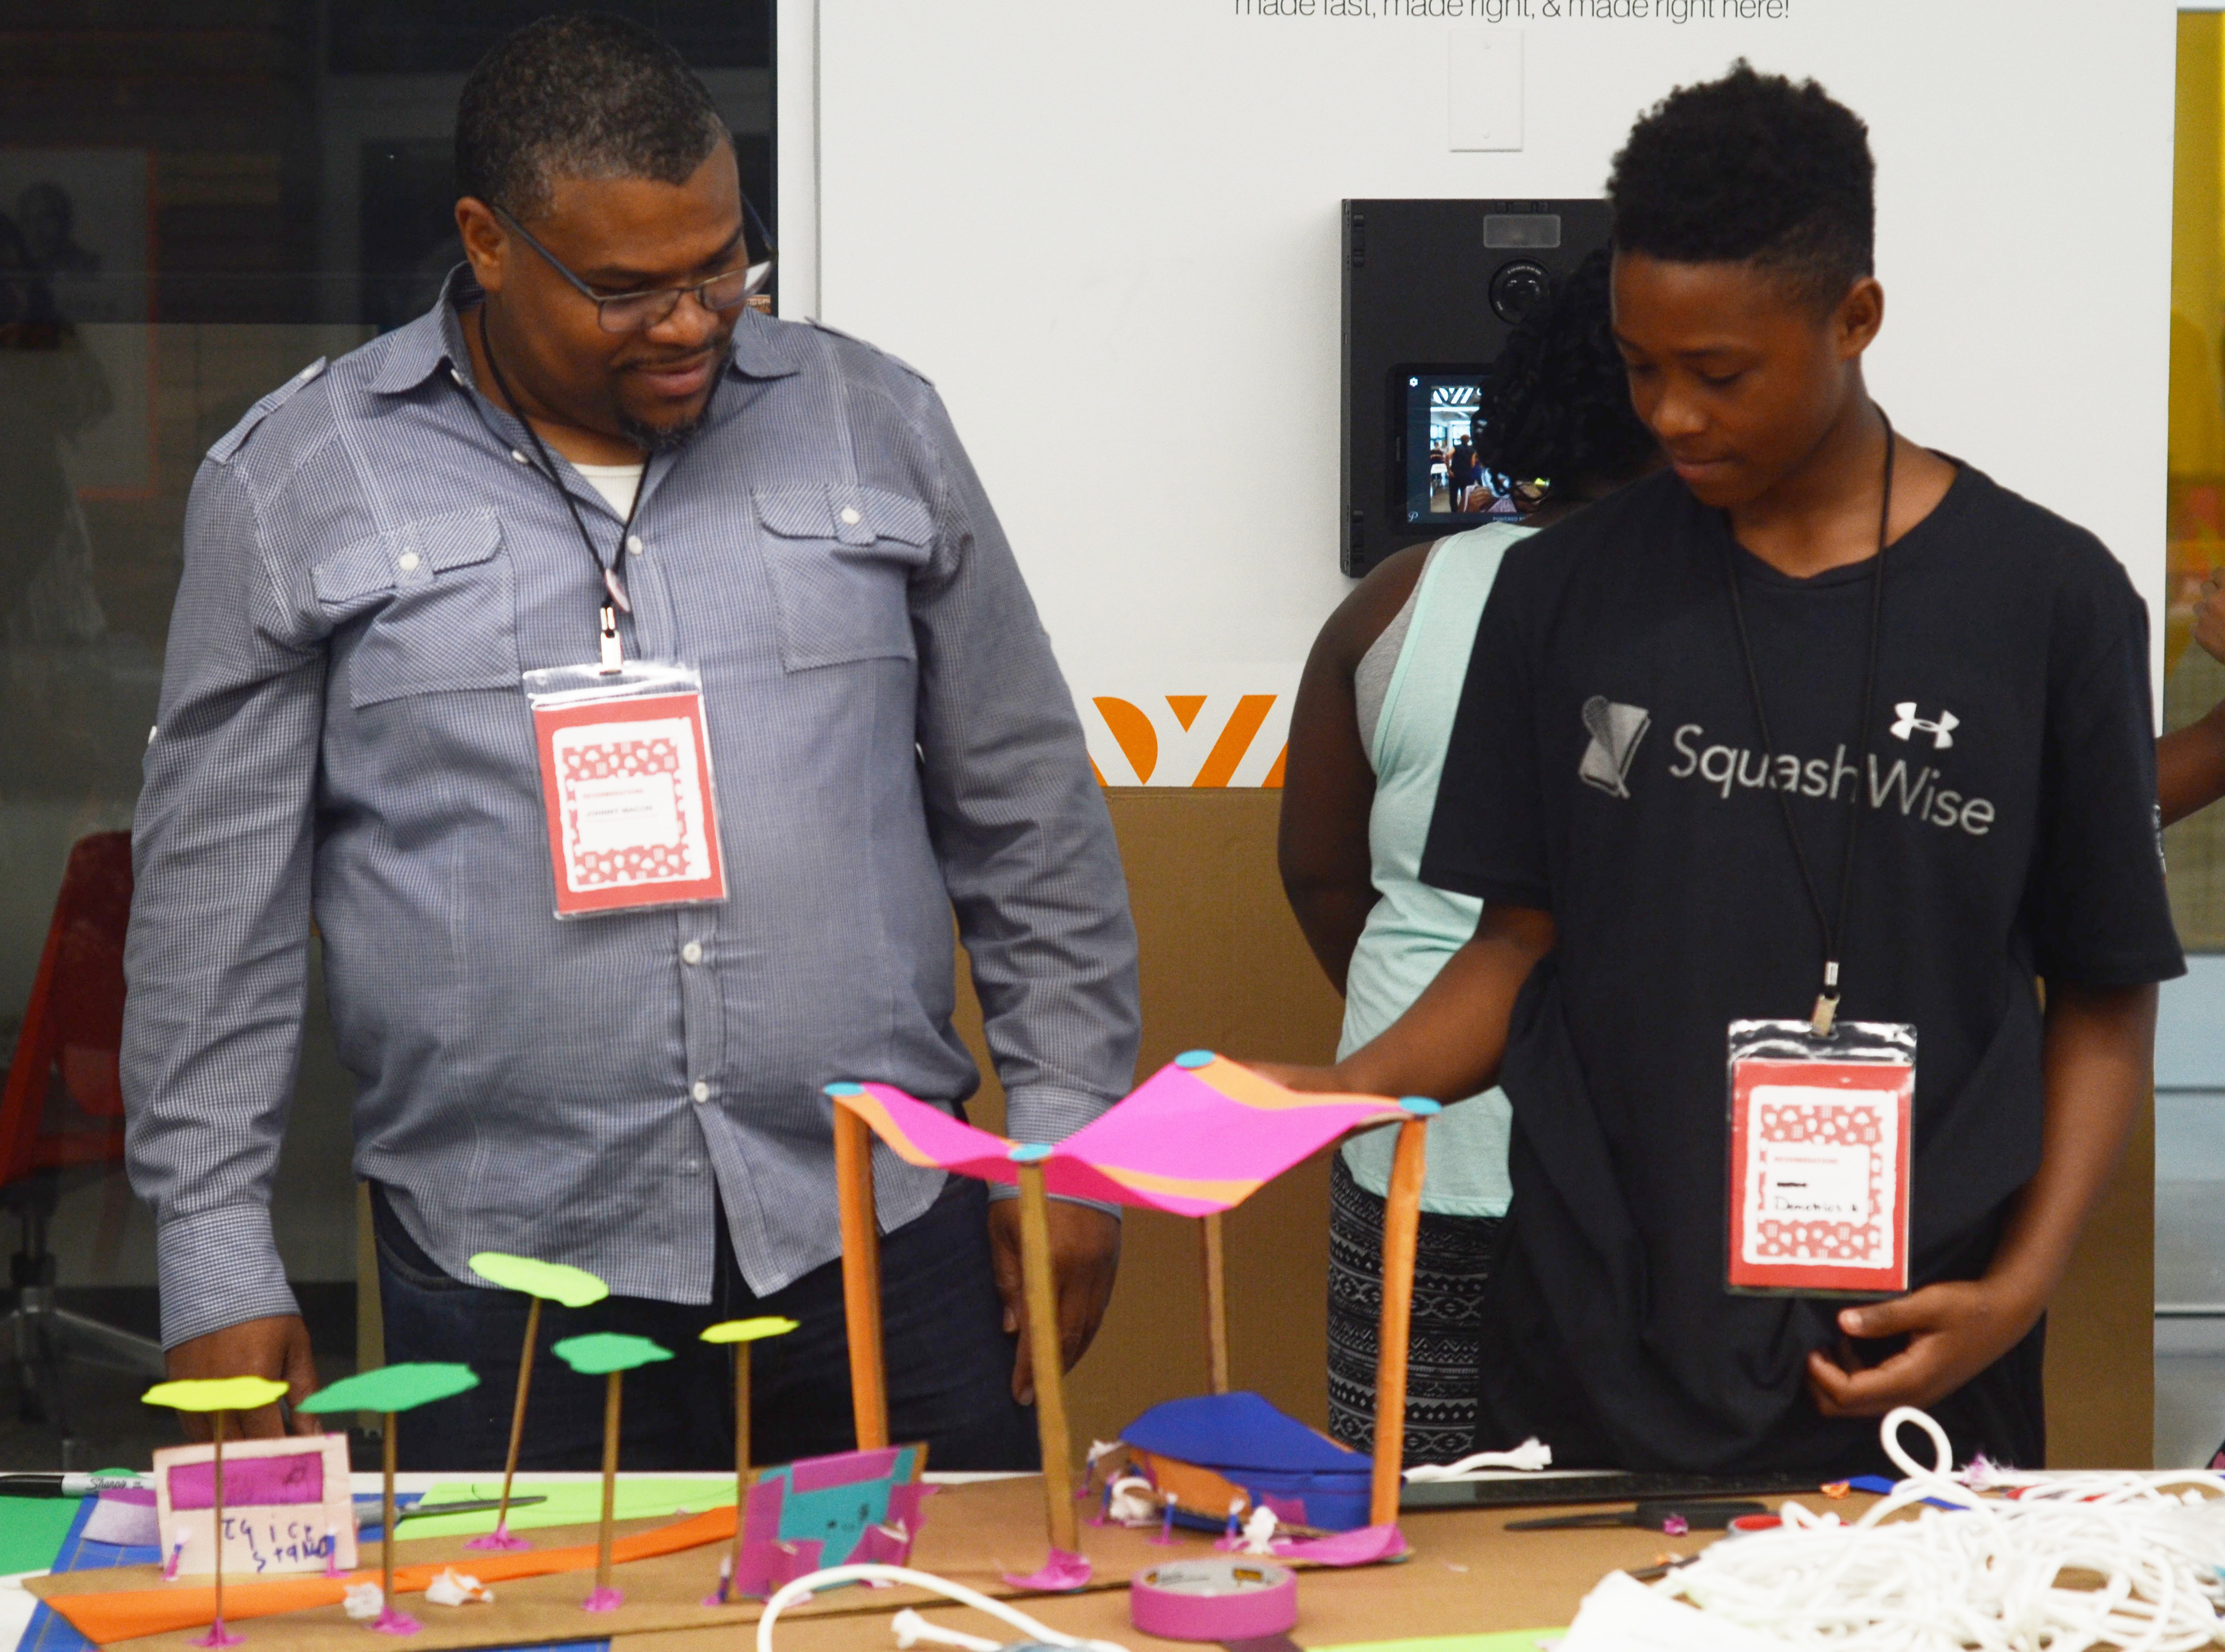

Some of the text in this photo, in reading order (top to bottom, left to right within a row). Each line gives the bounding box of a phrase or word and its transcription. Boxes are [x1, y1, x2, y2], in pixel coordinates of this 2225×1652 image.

[1235, 0, 1316, 16] made
[1384, 0, 1463, 17] made
[1542, 0, 1561, 17] &
[1569, 0, 1649, 18] made
[1656, 0, 1715, 24] right
